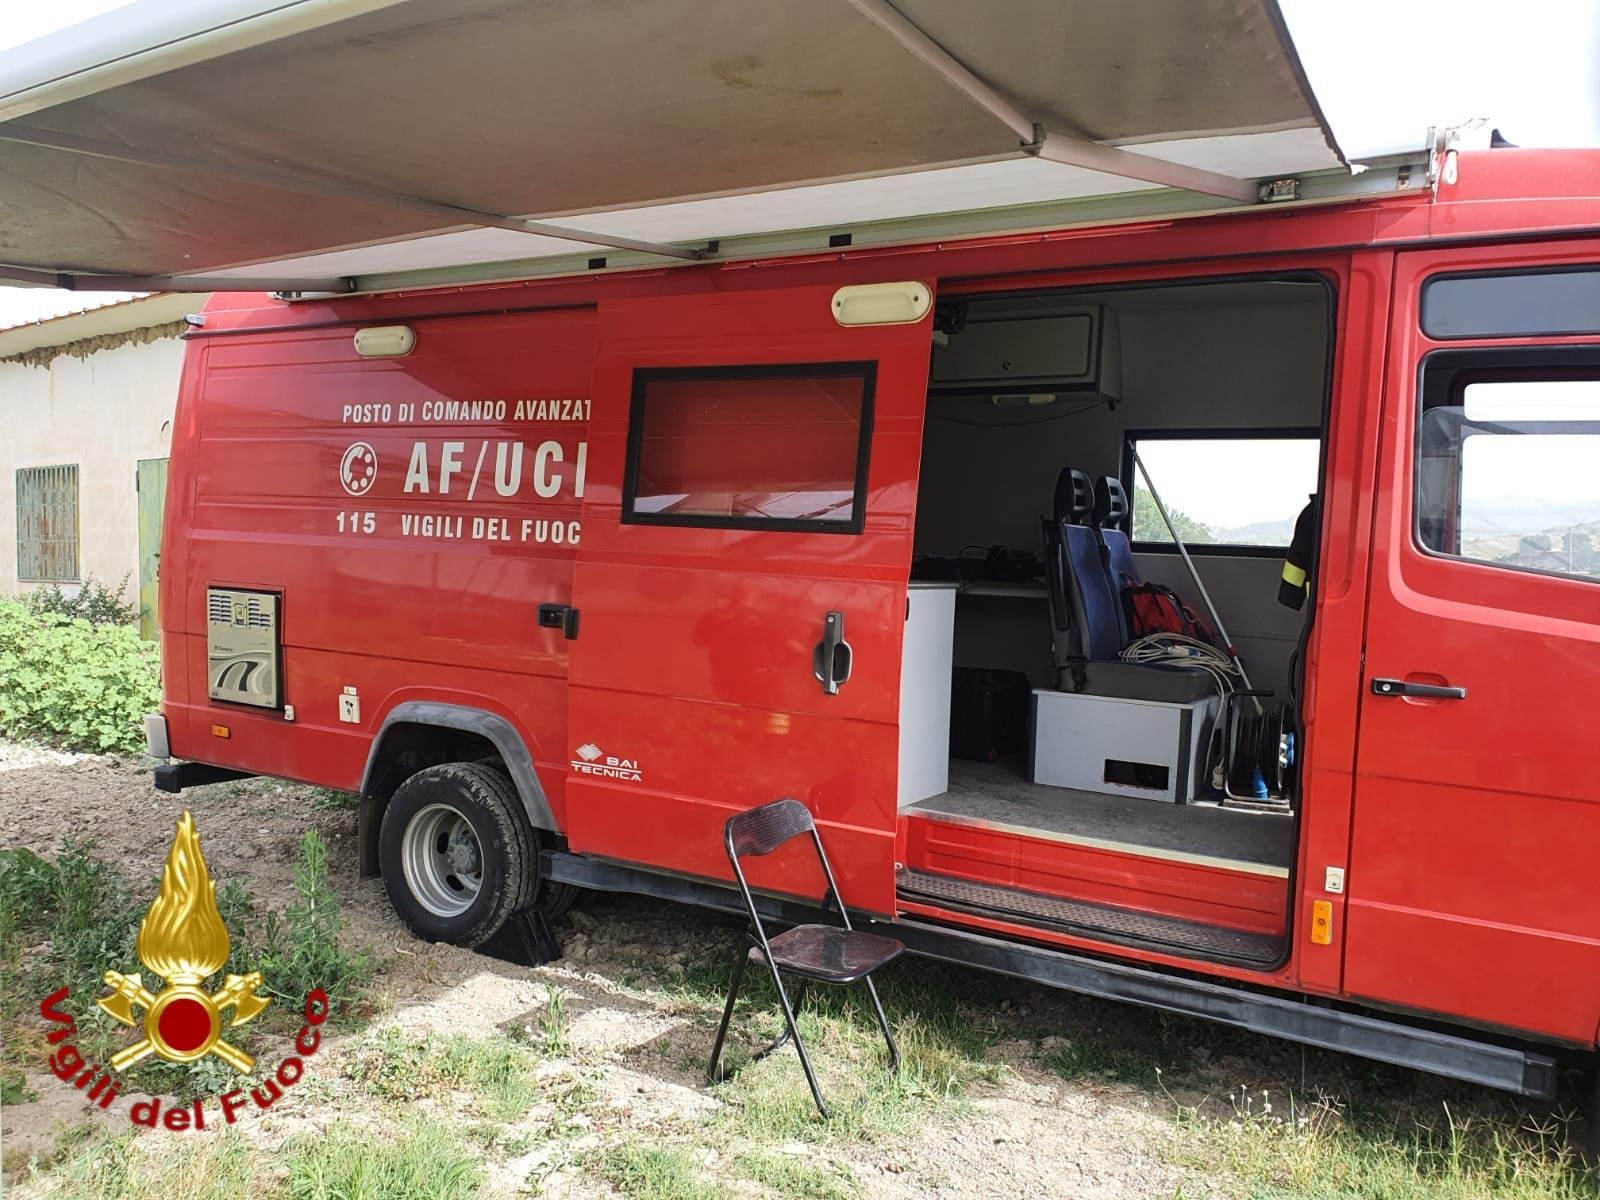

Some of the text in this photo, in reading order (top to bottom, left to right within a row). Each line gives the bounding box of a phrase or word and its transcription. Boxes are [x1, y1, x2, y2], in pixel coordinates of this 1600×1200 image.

[343, 399, 591, 423] POSTO DI COMANDO AVANZAT
[336, 512, 581, 544] 115 VIGILI DEL FUOC
[571, 764, 642, 782] TECNICA
[606, 757, 638, 769] BAI
